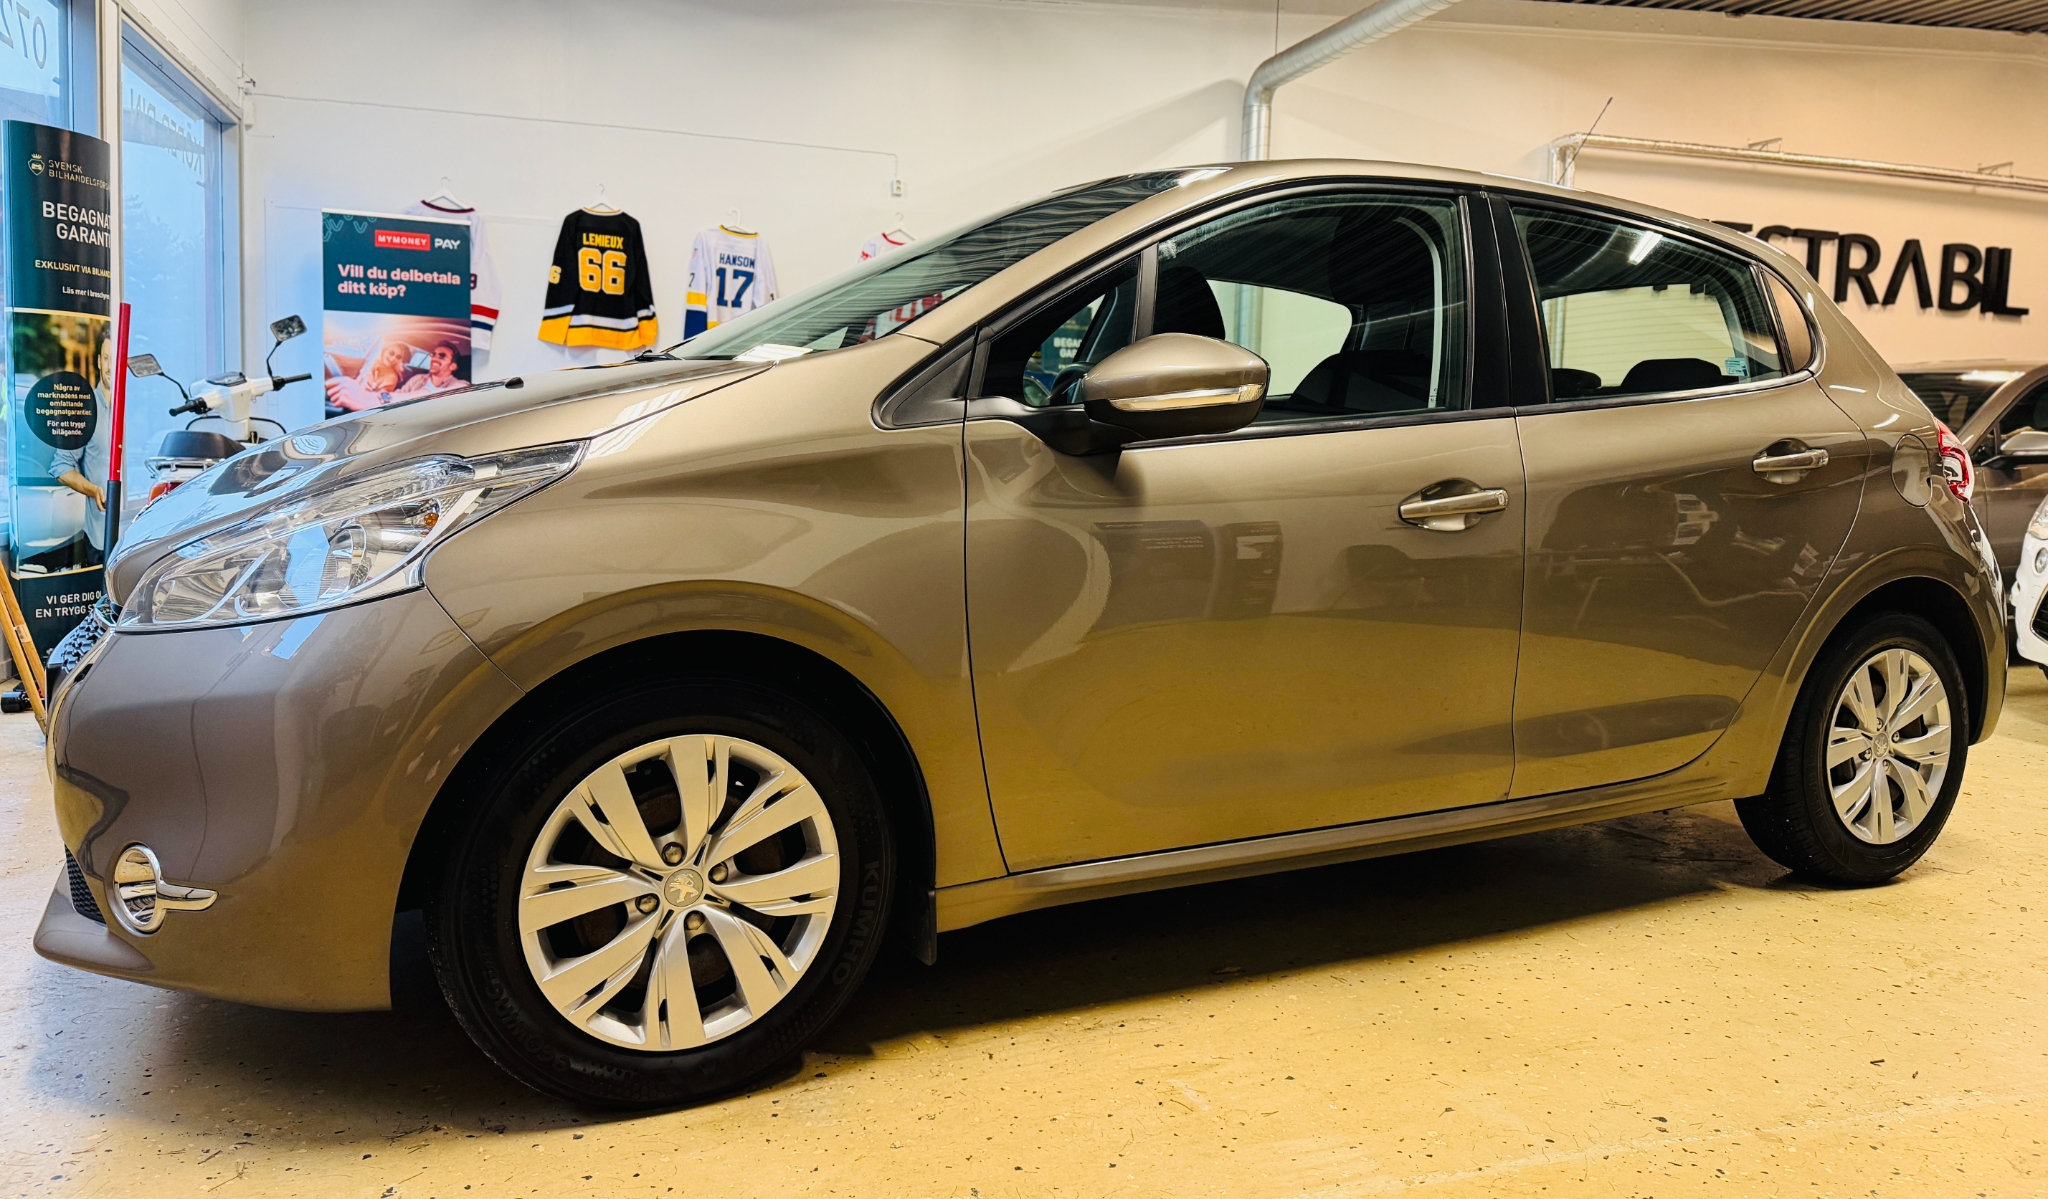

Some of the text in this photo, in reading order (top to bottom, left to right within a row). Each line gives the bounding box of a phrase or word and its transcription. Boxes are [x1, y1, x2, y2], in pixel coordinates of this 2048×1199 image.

[48, 160, 83, 173] SVENSK
[377, 235, 461, 250] MYMONEY PAY
[582, 232, 625, 250] LEMIEUX
[35, 259, 80, 272] EXKLUSIVT
[81, 265, 91, 275] VIA
[719, 252, 756, 270] HANSON
[337, 263, 364, 279] Vill
[366, 266, 388, 280] du
[390, 268, 461, 286] delbetala
[578, 246, 628, 296] 66
[62, 286, 74, 294] Läs
[337, 281, 407, 300] ditt köp?
[715, 266, 755, 309] 17
[46, 595, 58, 605] VI
[59, 593, 81, 604] GER
[81, 591, 96, 602] DIG
[35, 608, 53, 618] EN
[54, 605, 87, 617] TRYGG
[832, 860, 880, 985] KUMHO
